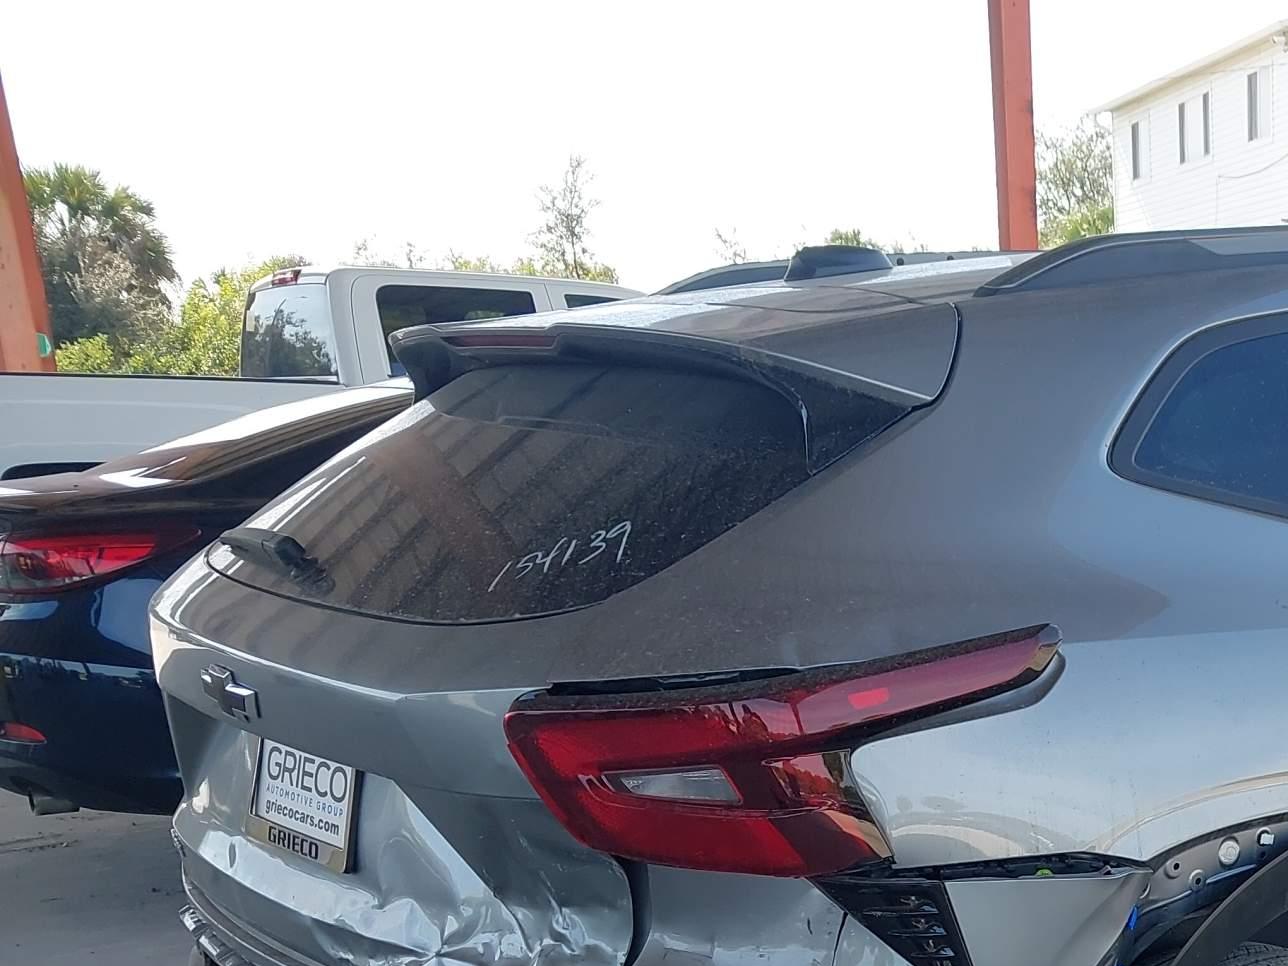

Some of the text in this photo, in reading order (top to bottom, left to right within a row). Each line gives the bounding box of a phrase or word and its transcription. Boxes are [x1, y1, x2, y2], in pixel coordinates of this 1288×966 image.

[267, 745, 348, 803] GRIECO
[265, 798, 340, 836] griecocars.com
[266, 783, 345, 817] AUTOMOTIVE GROUP
[268, 825, 319, 860] GRIECO
